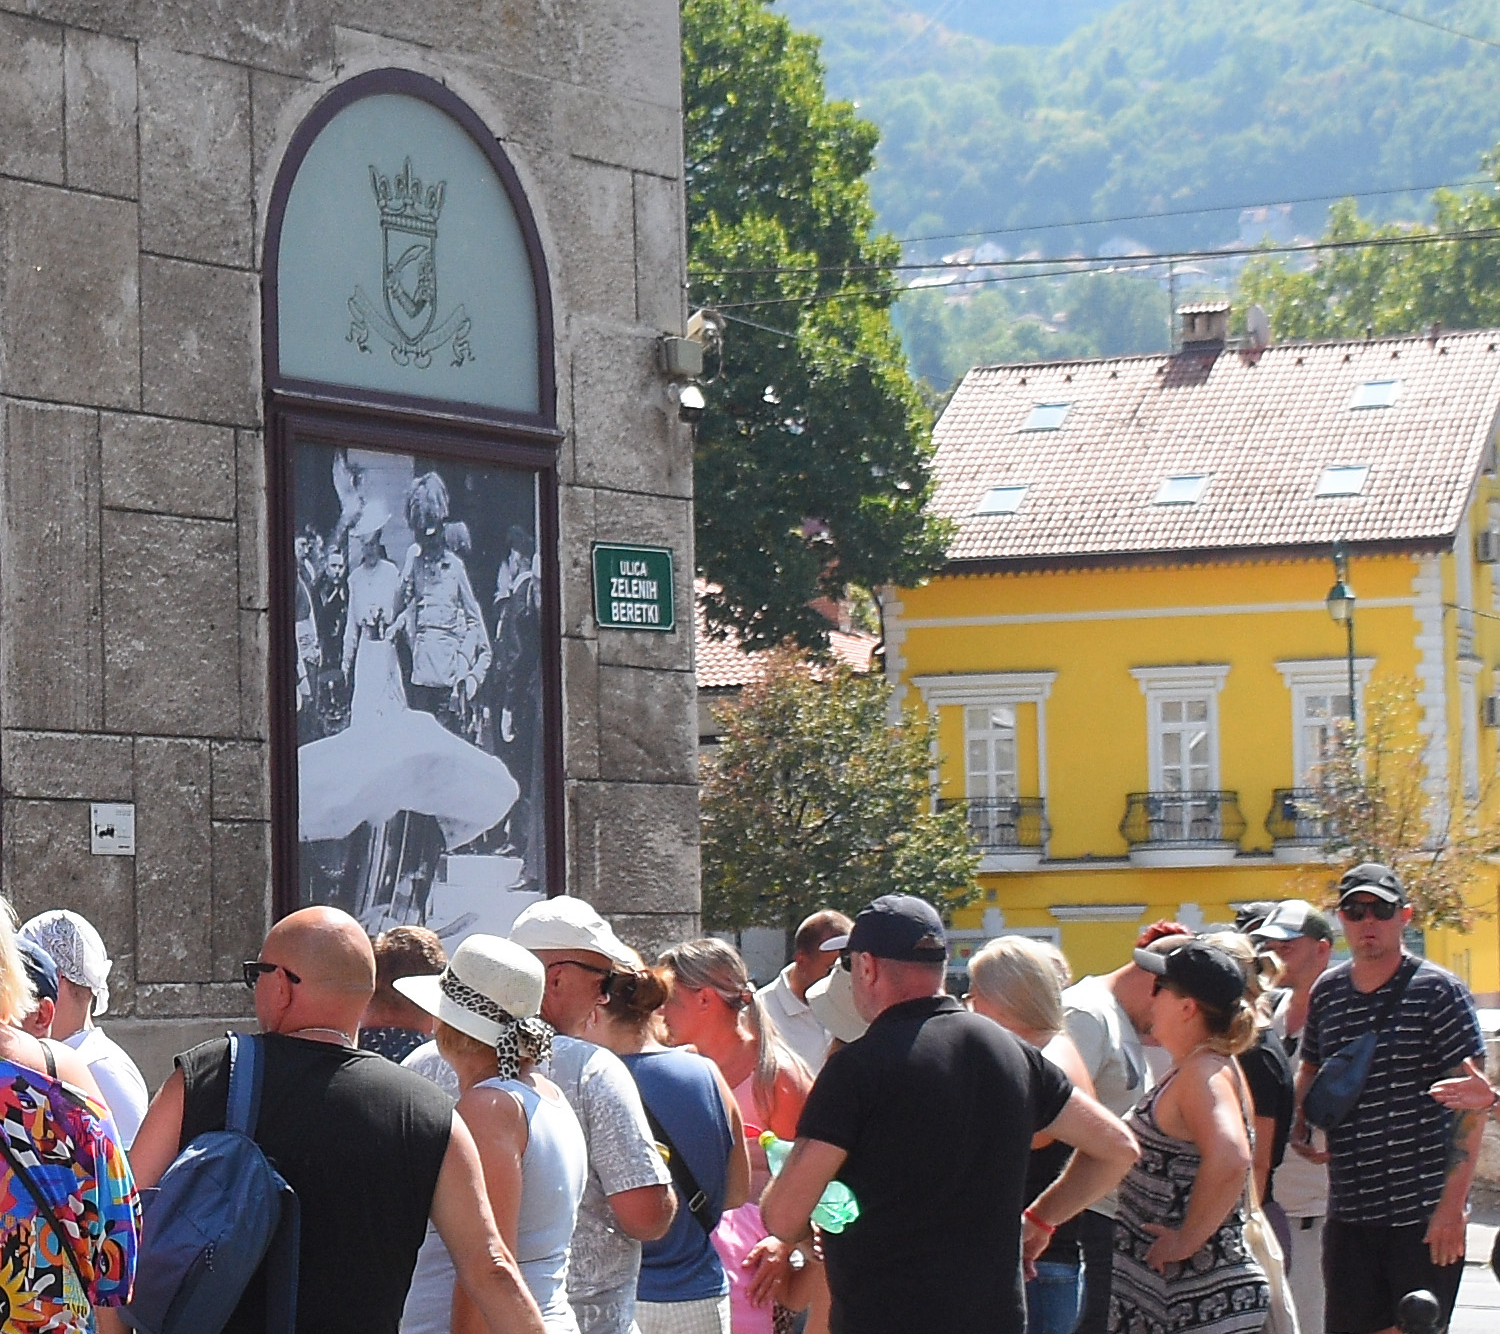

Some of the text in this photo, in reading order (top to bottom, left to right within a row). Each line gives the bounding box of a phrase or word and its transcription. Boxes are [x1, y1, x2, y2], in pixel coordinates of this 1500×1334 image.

[619, 560, 648, 577] ULICA
[610, 578, 658, 600] ZELENIH
[611, 601, 659, 624] BERETKI
